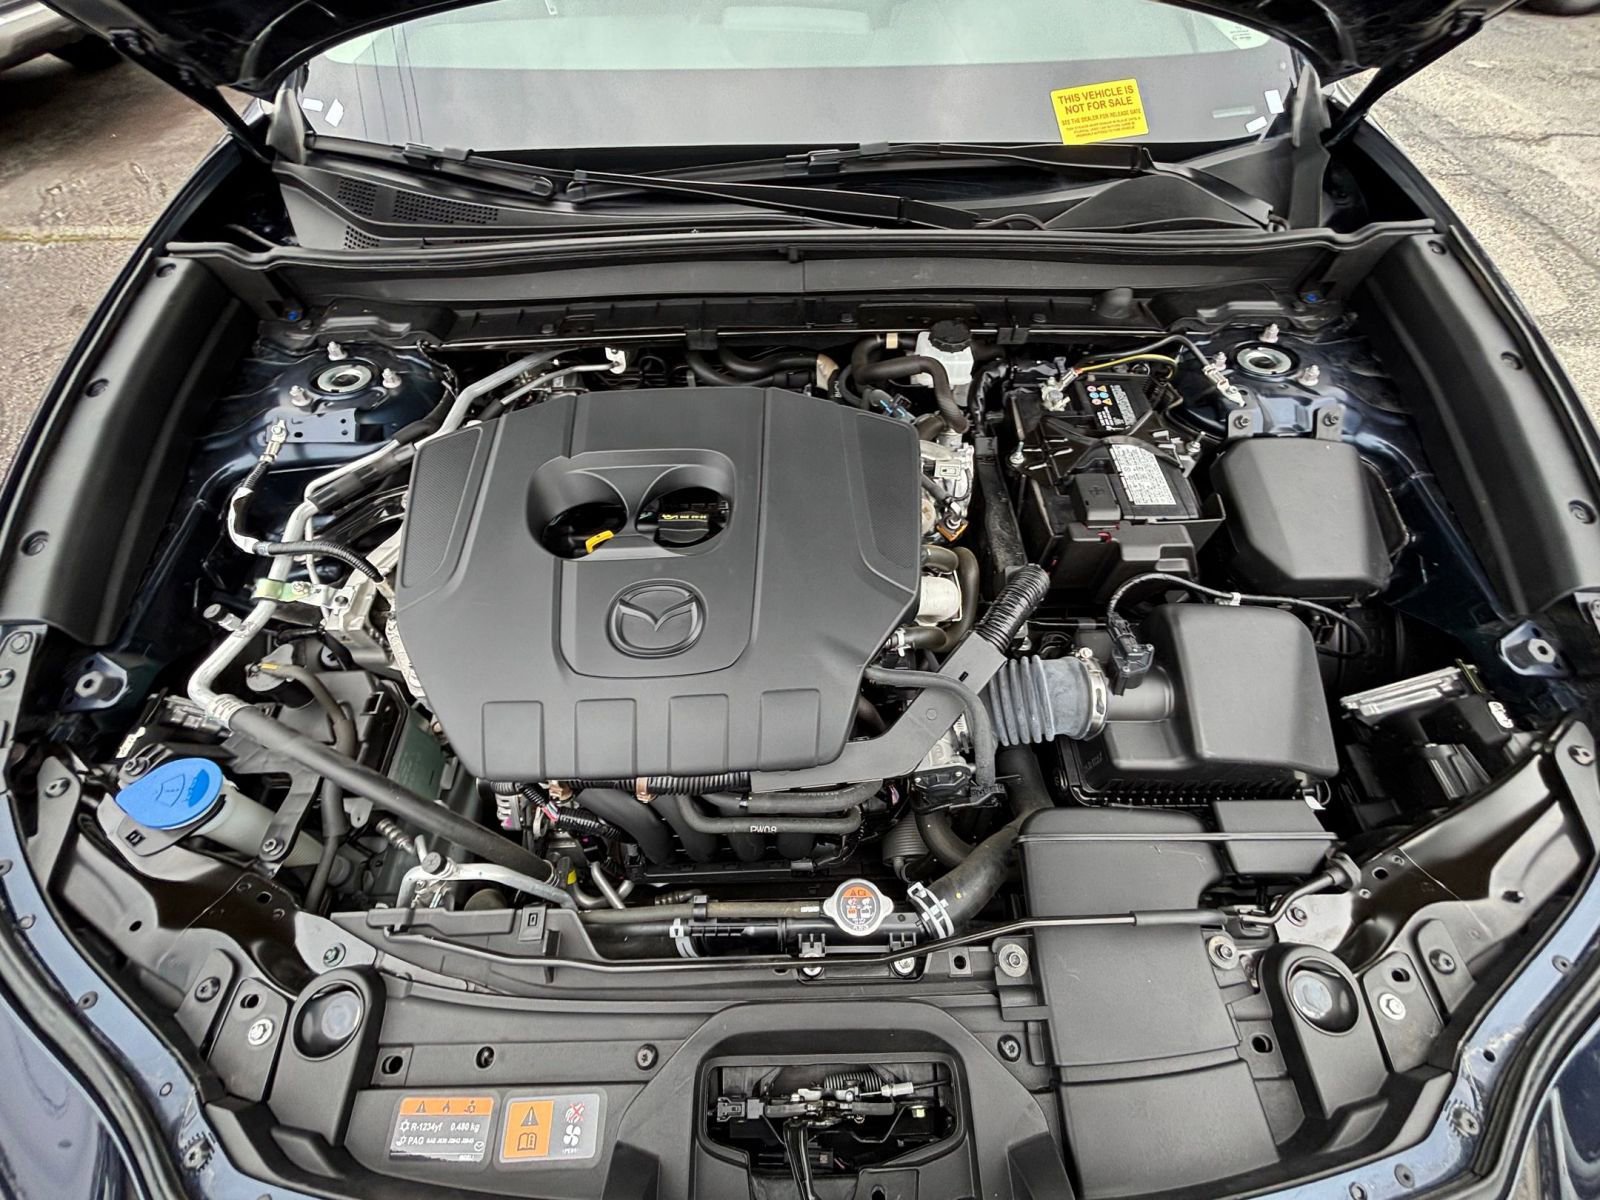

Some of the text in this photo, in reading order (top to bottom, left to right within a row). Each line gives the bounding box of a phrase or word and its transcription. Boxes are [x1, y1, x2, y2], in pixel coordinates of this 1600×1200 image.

[1058, 85, 1134, 104] THIS VEHICLE IS
[1065, 96, 1133, 114] NOT FOR SALE
[470, 1122, 480, 1133] kg
